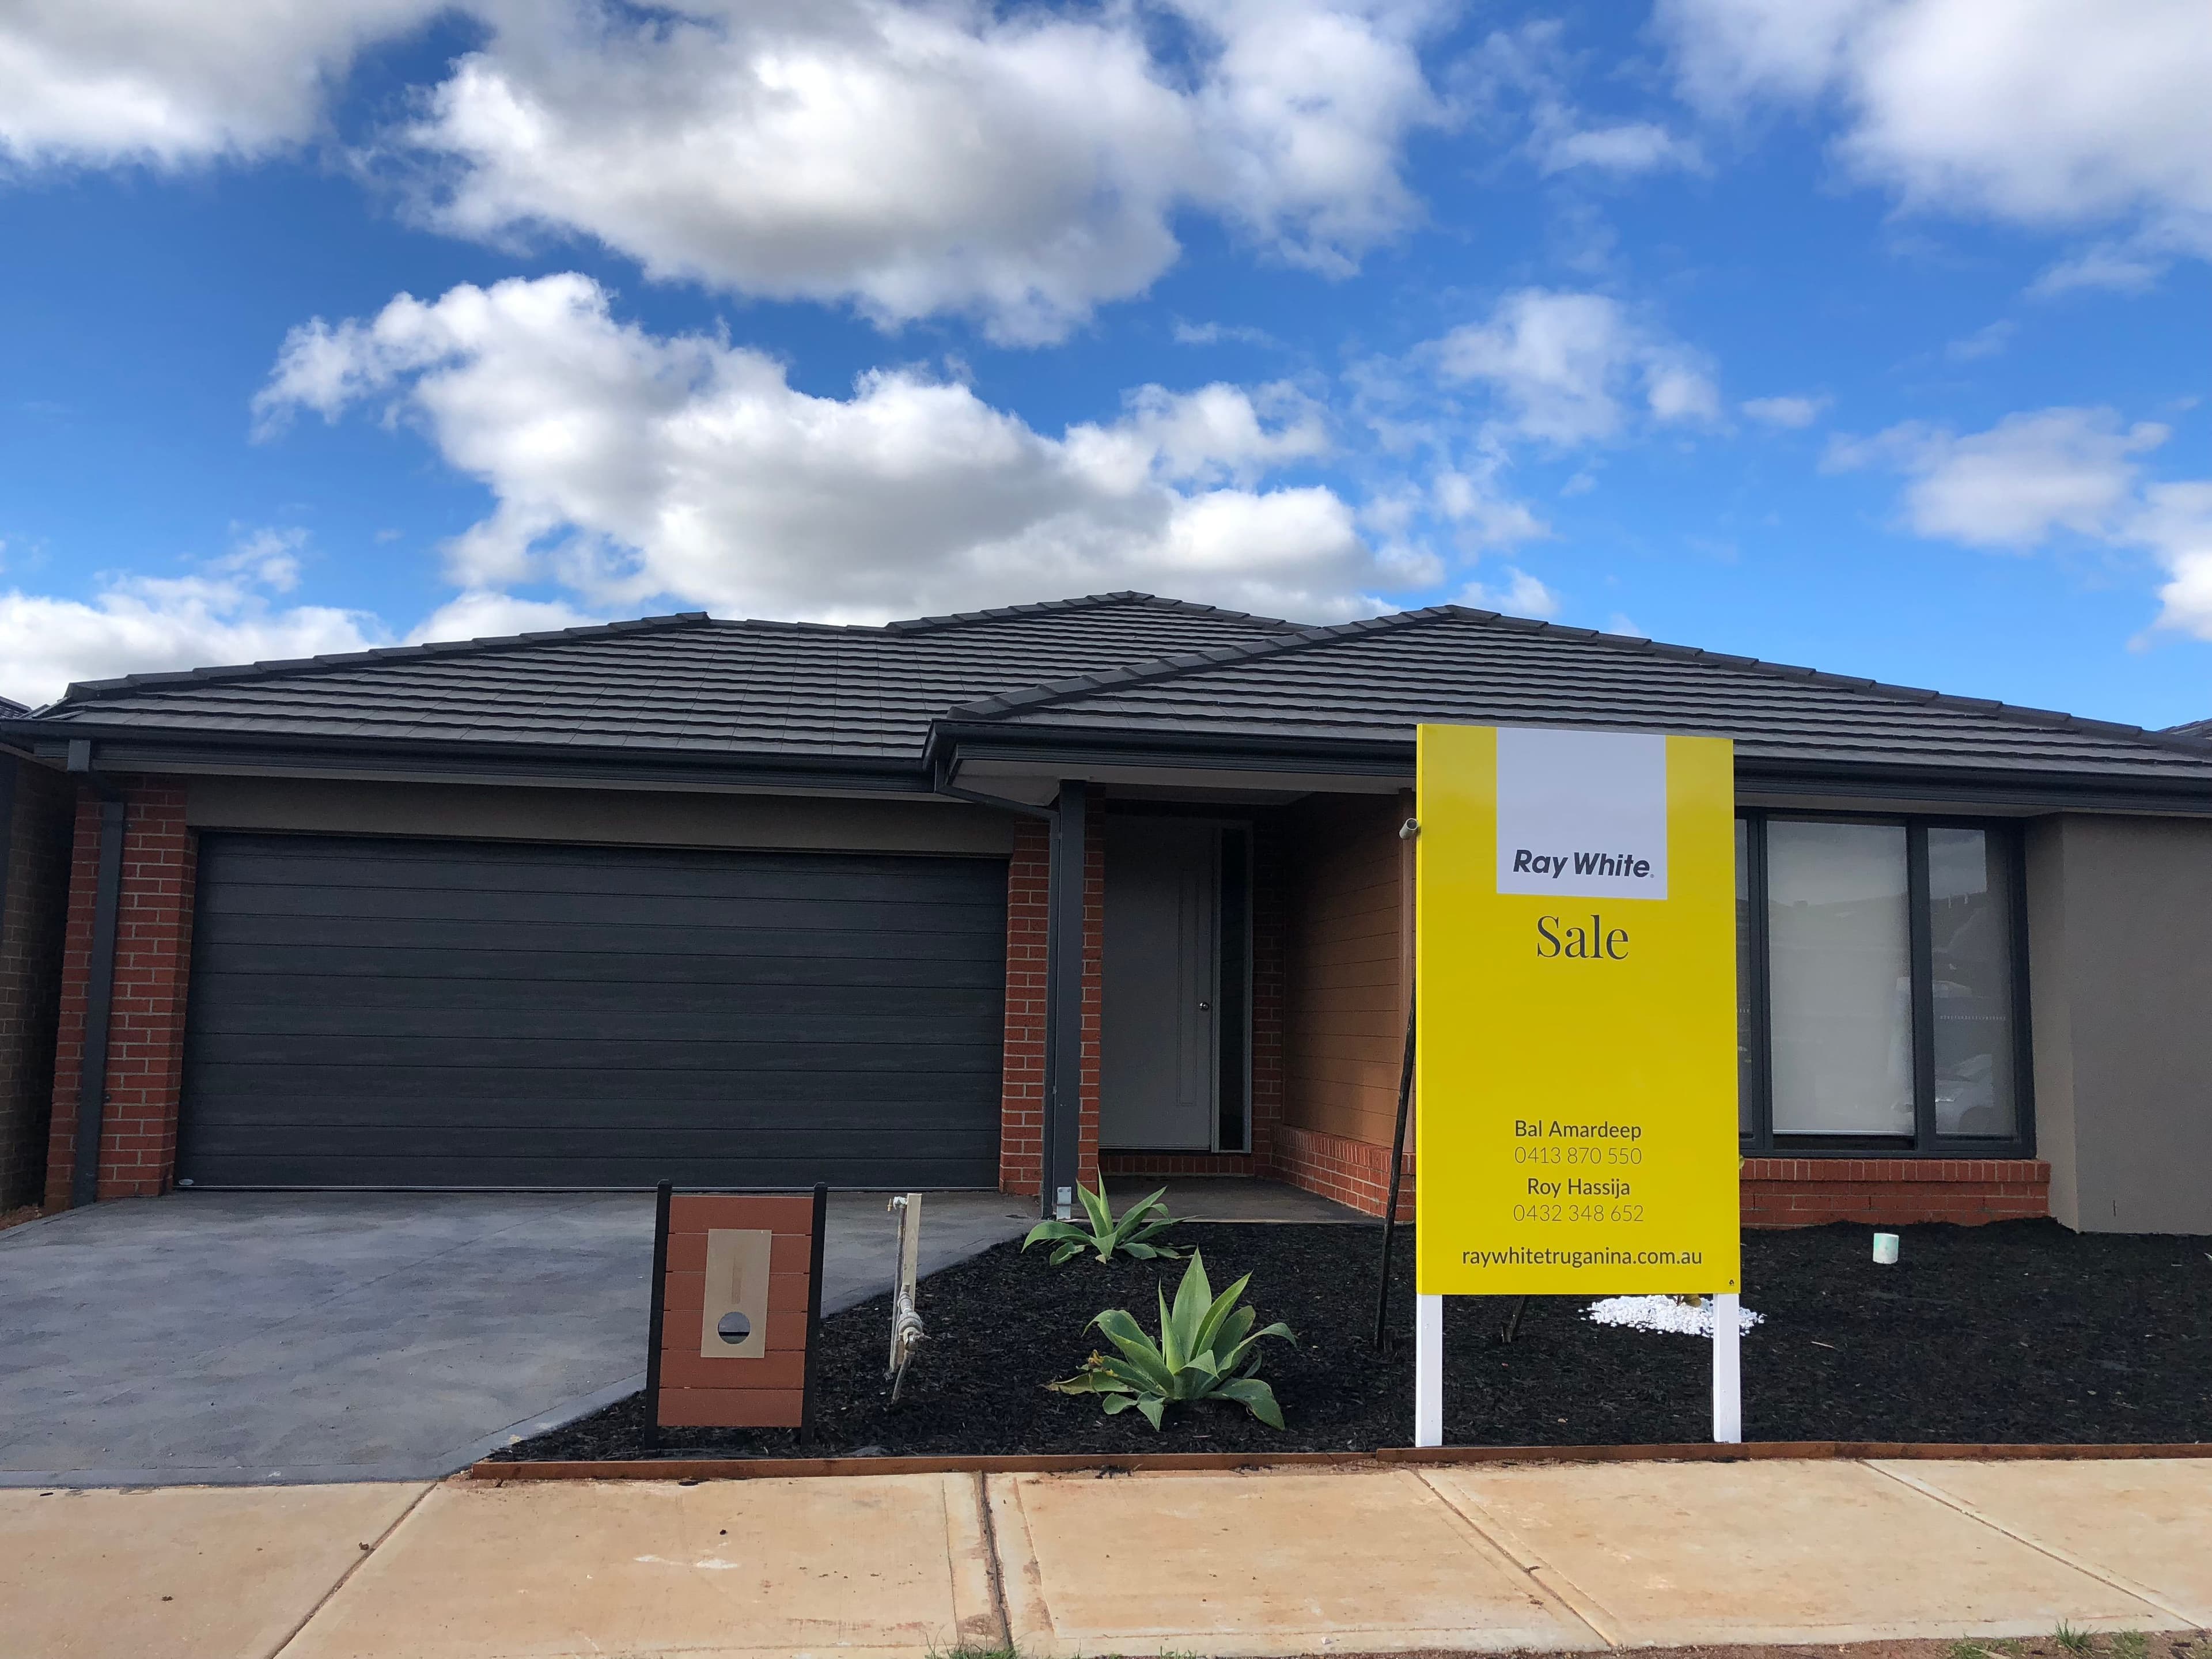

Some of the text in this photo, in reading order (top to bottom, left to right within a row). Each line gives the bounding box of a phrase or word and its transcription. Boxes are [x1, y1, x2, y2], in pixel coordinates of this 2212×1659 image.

[1513, 849, 1650, 879] Ray White
[1537, 914, 1629, 960] Sale
[1515, 1120, 1641, 1141] Bal Amardeep
[1514, 1146, 1642, 1165] 0413 870 550
[1528, 1177, 1630, 1199] Roy Hassija
[1513, 1204, 1644, 1222] 0432 348 652
[1462, 1246, 1702, 1268] raywhitetruganina.com.au
